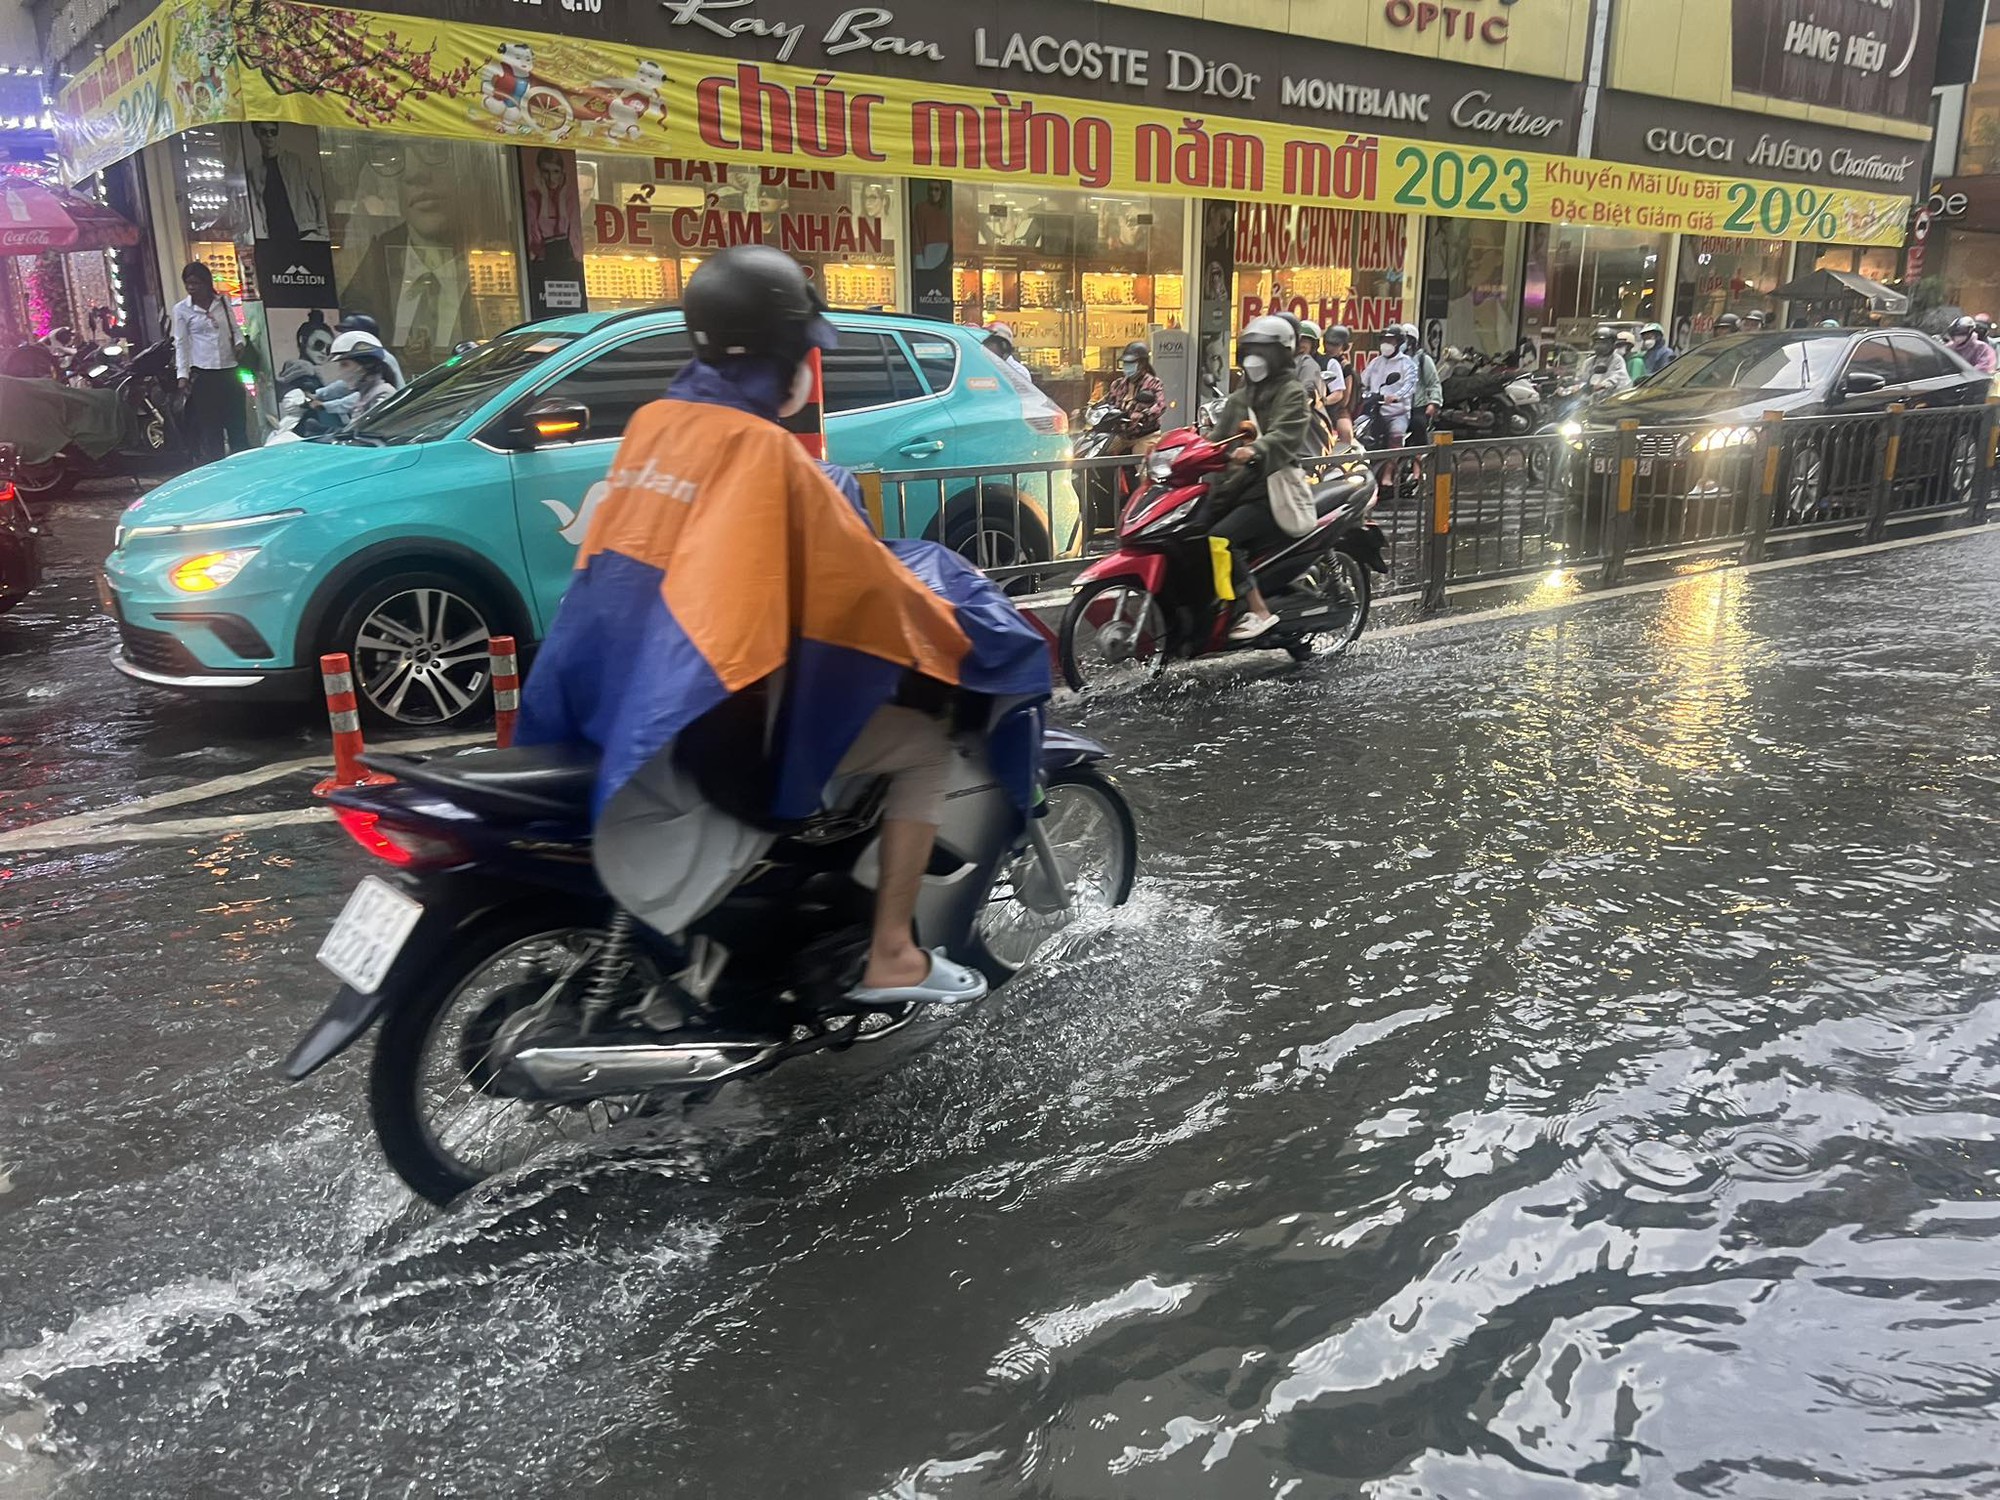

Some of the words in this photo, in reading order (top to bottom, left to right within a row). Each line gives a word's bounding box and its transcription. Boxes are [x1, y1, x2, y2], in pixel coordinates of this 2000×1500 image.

[822, 8, 946, 62] Ban
[1385, 0, 1508, 45] OPTIC
[134, 20, 162, 75] 2023
[974, 28, 1148, 86] LACOSTE
[1281, 75, 1430, 122] MONTBLANC
[1450, 90, 1563, 137] Cartier
[697, 63, 886, 162] chúc
[912, 92, 1112, 188] mừng
[1135, 118, 1264, 191] năm
[1283, 134, 1379, 201] mới
[1394, 147, 1529, 214] 2023
[1646, 127, 1735, 161] GUCCI
[1545, 161, 1622, 192] Khuyến
[1627, 171, 1661, 194] Mãi
[1666, 175, 1689, 197] Ưu
[1694, 180, 1721, 201] Đãi
[1830, 147, 1914, 183] Charmant
[594, 183, 656, 246] ĐỂ
[671, 193, 764, 249] CẢM
[780, 206, 882, 261] NHẬN
[1551, 198, 1588, 223] Đặc
[1593, 202, 1631, 227] Biệt
[1637, 206, 1682, 229] Giảm
[1687, 211, 1714, 231] Giá
[1723, 183, 1838, 240] 20%
[272, 274, 325, 285] MOLSION
